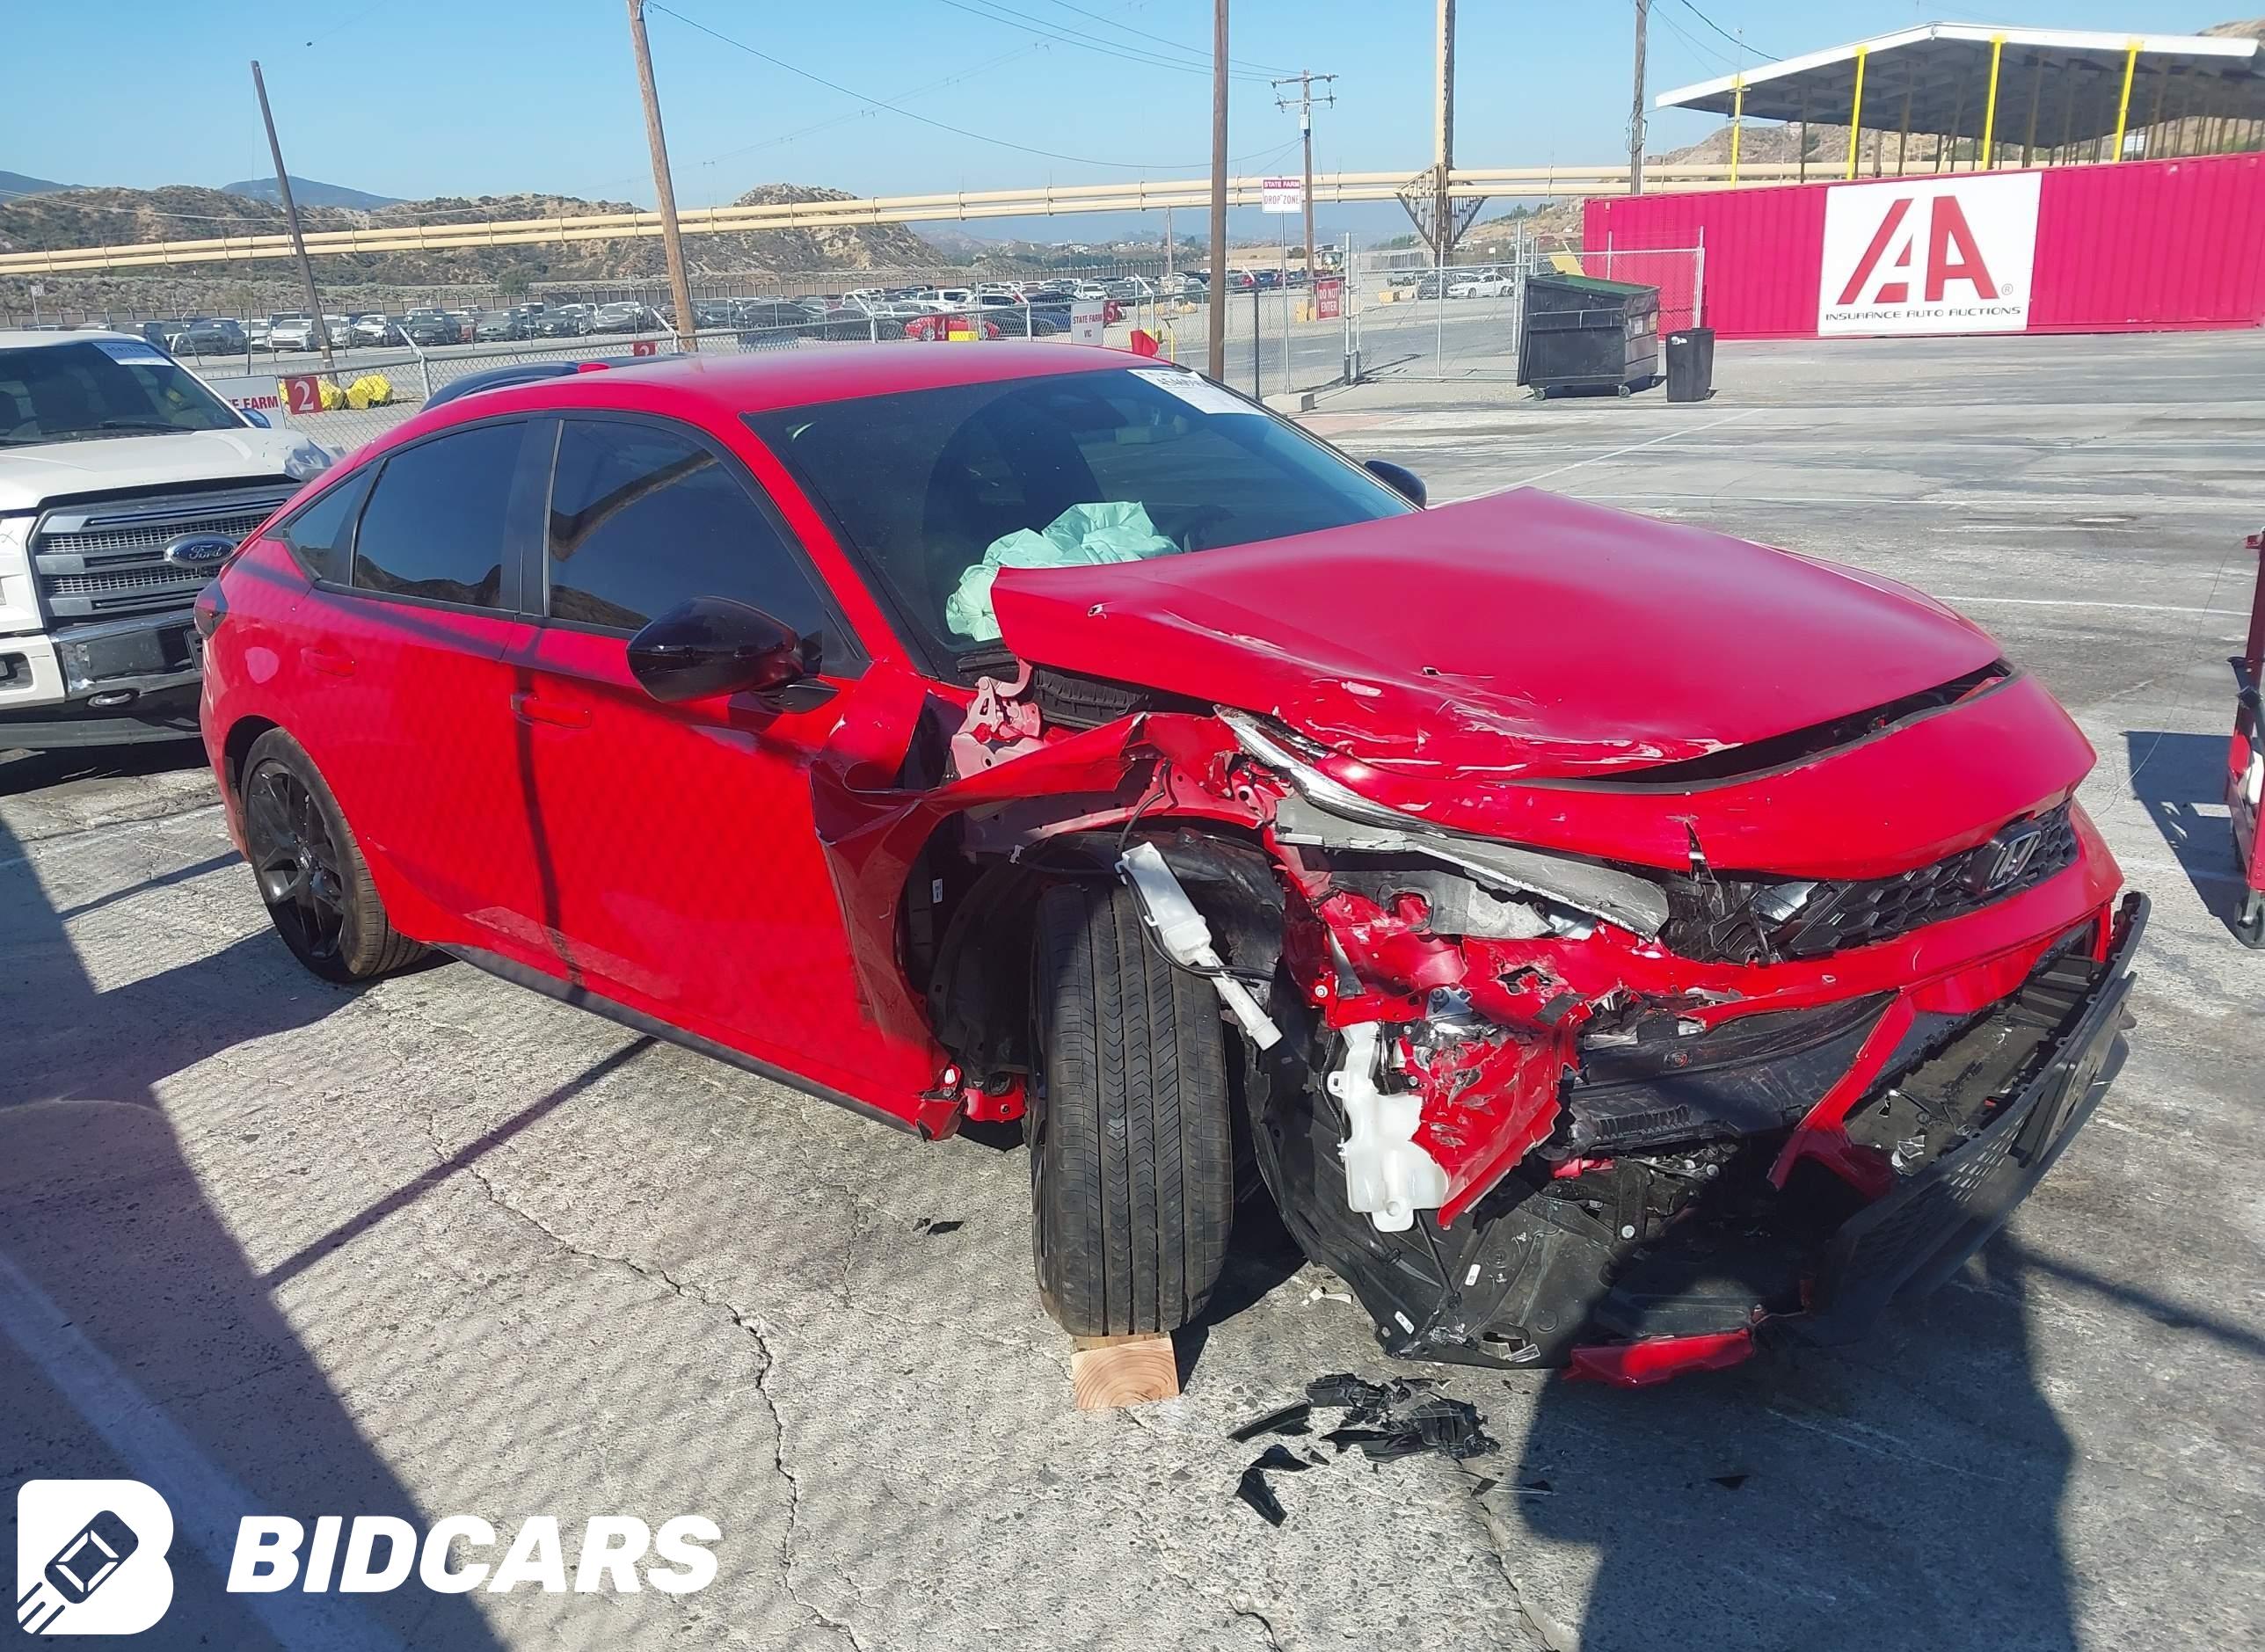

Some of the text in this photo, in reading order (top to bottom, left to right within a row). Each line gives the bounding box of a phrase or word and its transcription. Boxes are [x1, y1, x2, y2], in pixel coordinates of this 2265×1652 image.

[1264, 194, 1300, 204] DROP ZONE
[1319, 287, 1338, 299] DO NOT
[1108, 301, 1115, 321] 5
[1321, 301, 1337, 312] ENTER
[1073, 313, 1103, 324] STATE FARM
[1825, 307, 2021, 321] INSURANCE AUTO AUCTIONS
[937, 317, 947, 339] 4
[243, 396, 279, 409] FARM
[295, 381, 315, 411] 2
[189, 544, 222, 560] Ford
